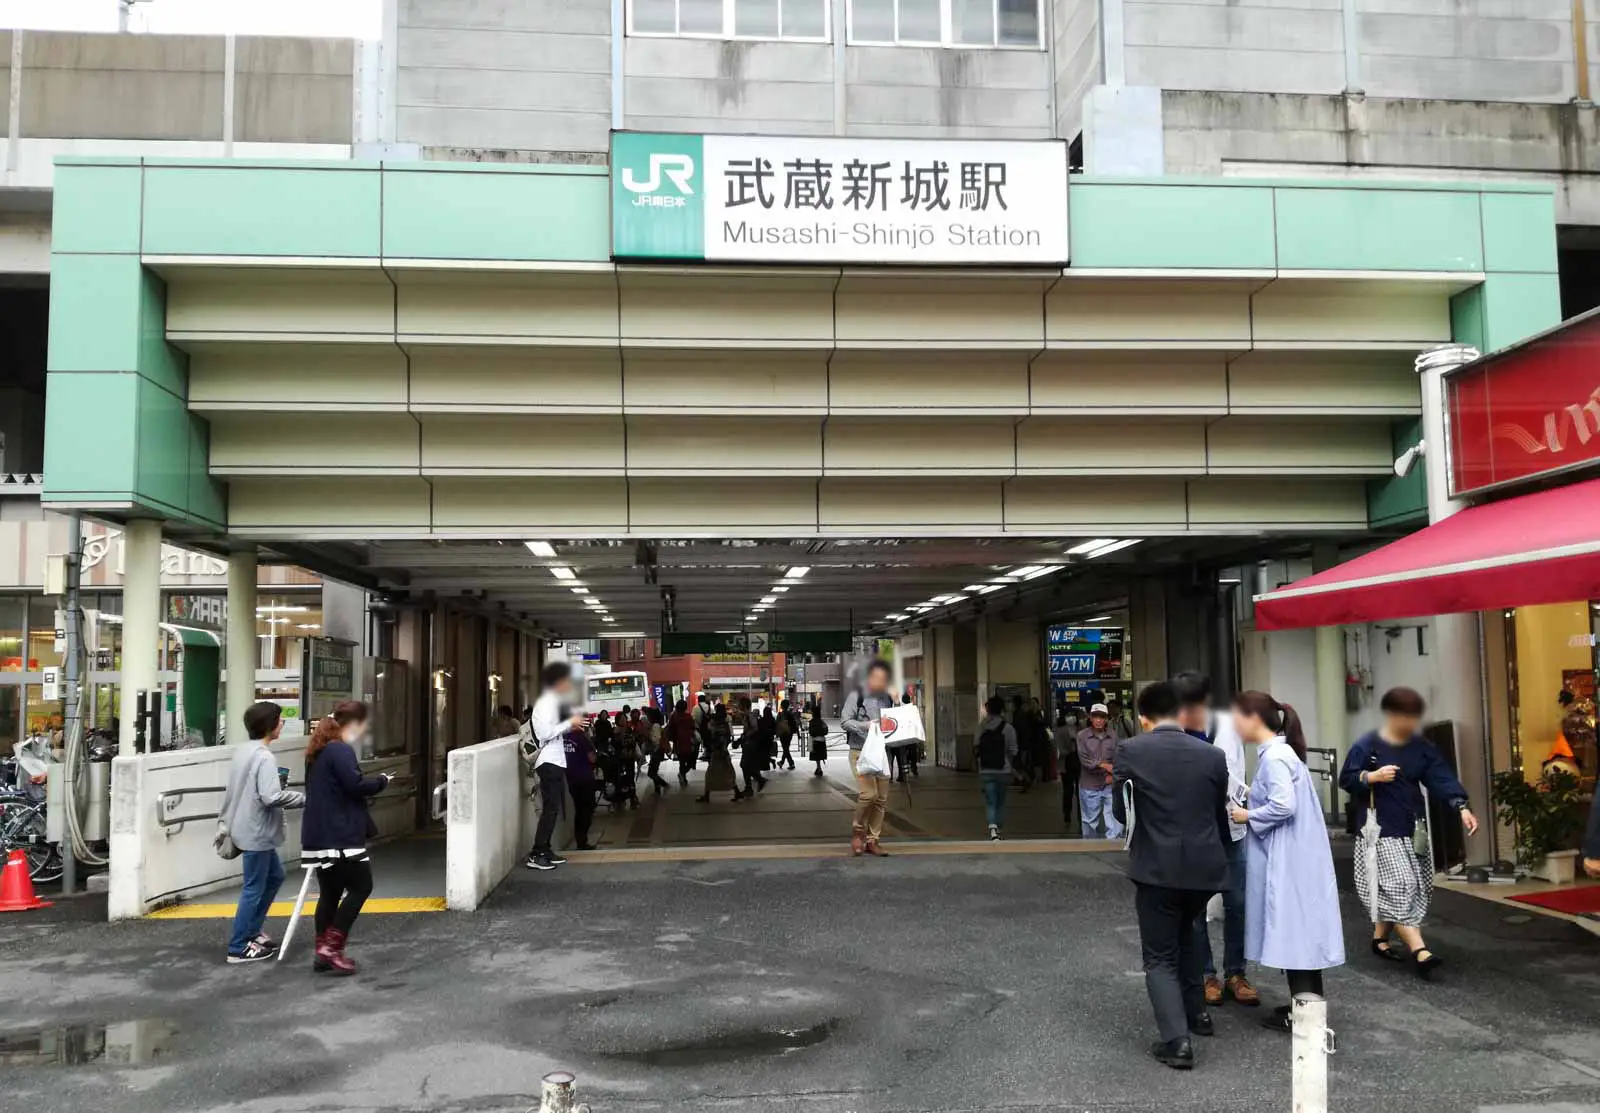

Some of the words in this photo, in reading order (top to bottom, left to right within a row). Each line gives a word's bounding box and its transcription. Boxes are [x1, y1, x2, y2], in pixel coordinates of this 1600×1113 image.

[621, 152, 696, 195] JR
[724, 156, 1008, 212] 武蔵新城駅
[631, 195, 688, 208] JR東日本
[723, 221, 935, 250] Musashi-Shinjō
[947, 223, 1042, 247] Station
[725, 635, 747, 647] JR
[1056, 679, 1078, 688] VIEW
